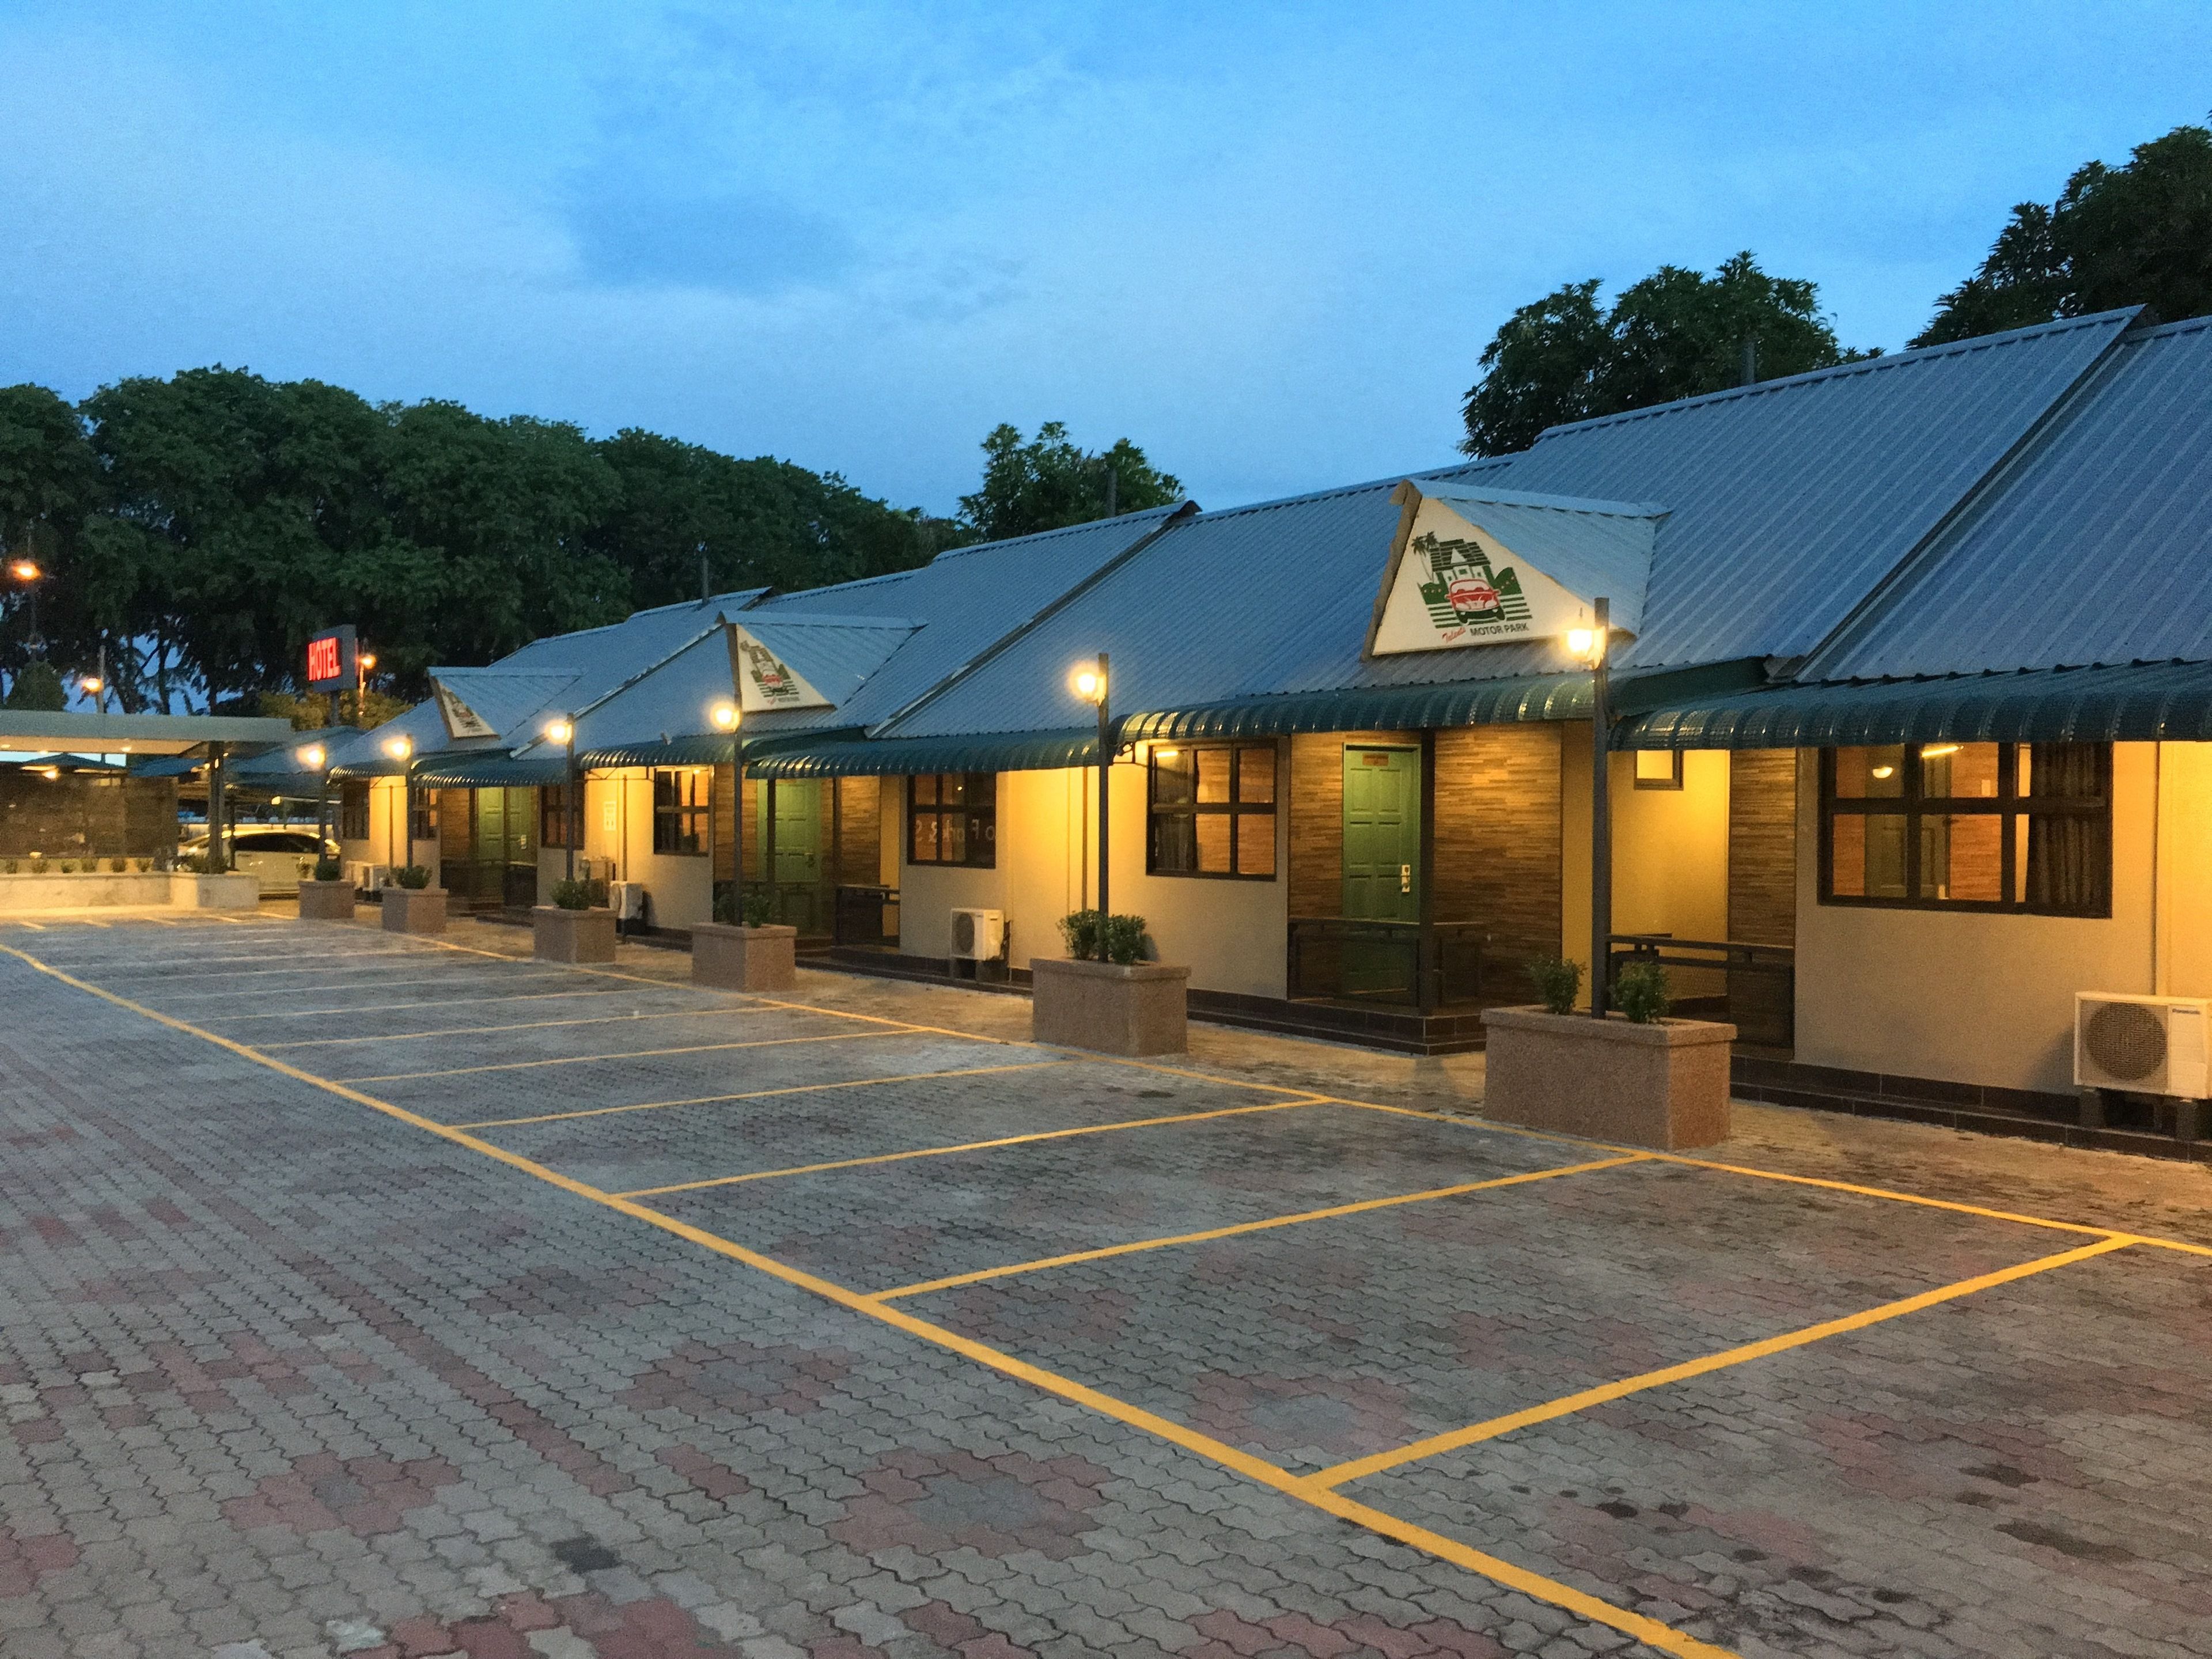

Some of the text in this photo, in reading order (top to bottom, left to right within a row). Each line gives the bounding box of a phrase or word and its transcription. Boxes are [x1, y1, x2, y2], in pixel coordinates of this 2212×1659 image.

[1470, 626, 1503, 636] MOTOR
[1504, 623, 1529, 632] PARK
[309, 637, 341, 681] HOTEL
